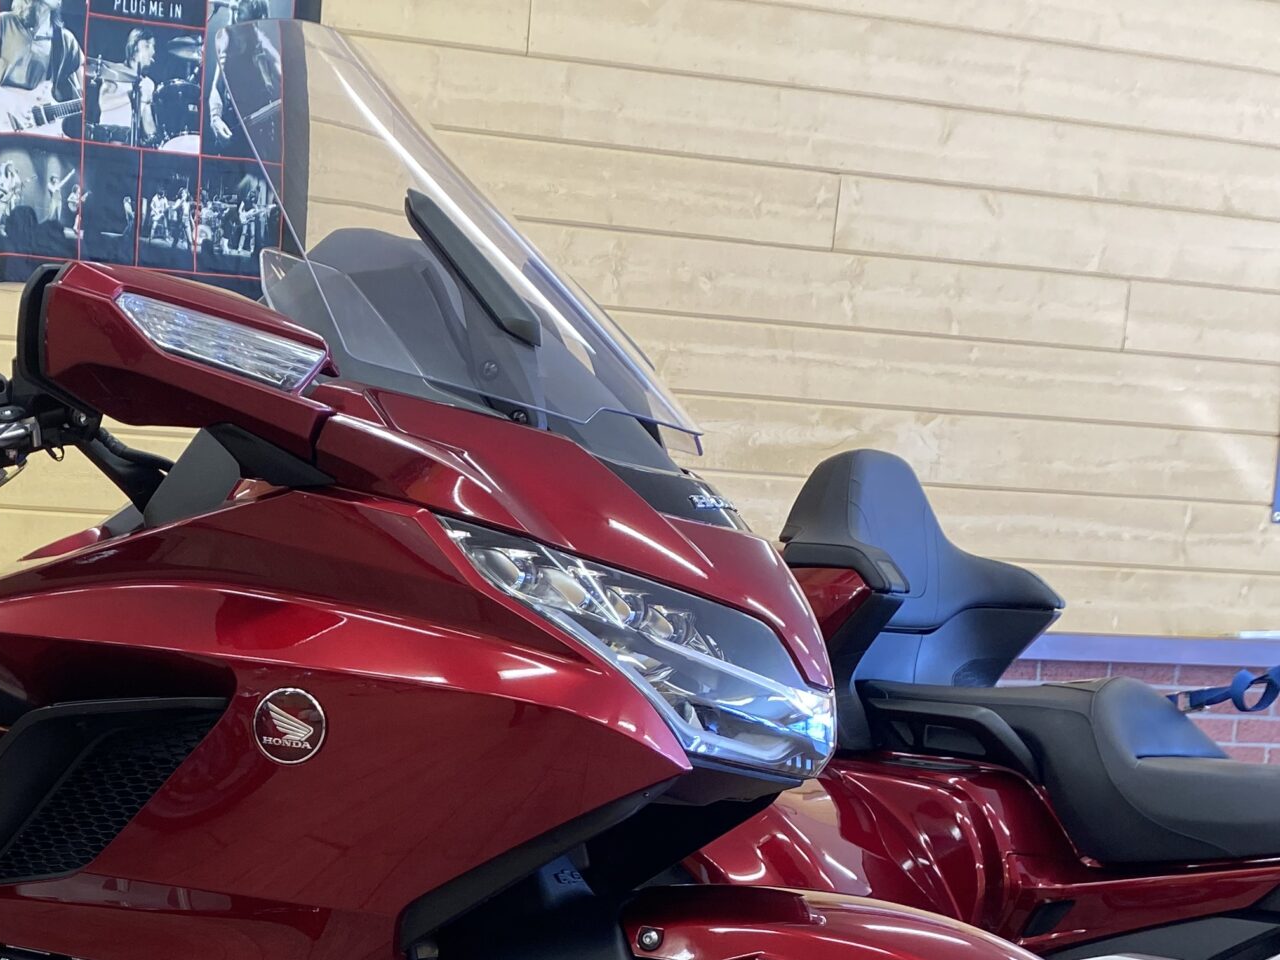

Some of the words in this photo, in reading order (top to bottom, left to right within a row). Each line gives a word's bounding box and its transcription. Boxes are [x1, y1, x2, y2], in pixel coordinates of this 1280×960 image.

[114, 0, 146, 14] PLUG
[149, 1, 164, 17] ME
[170, 3, 182, 18] IN
[262, 736, 312, 749] HONDA
